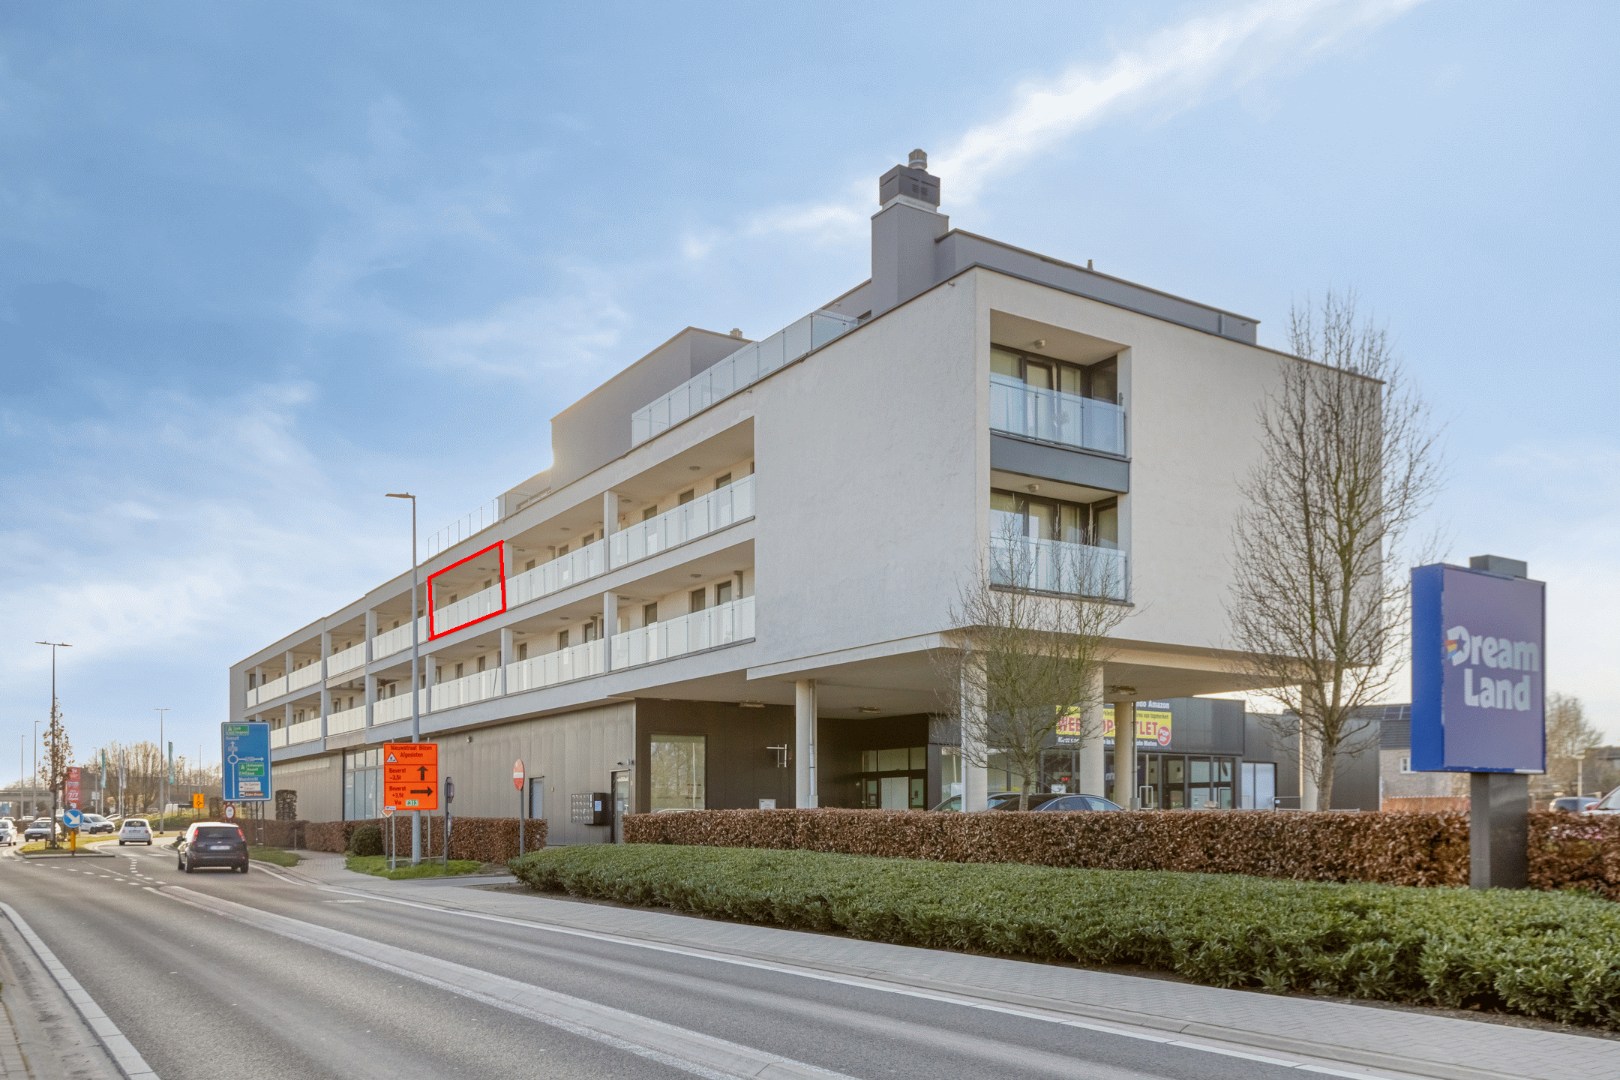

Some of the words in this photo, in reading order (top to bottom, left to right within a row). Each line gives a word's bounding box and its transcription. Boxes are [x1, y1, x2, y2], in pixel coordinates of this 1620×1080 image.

[1445, 625, 1539, 672] Dream
[1148, 700, 1170, 709] Amazon
[1464, 668, 1531, 711] Land
